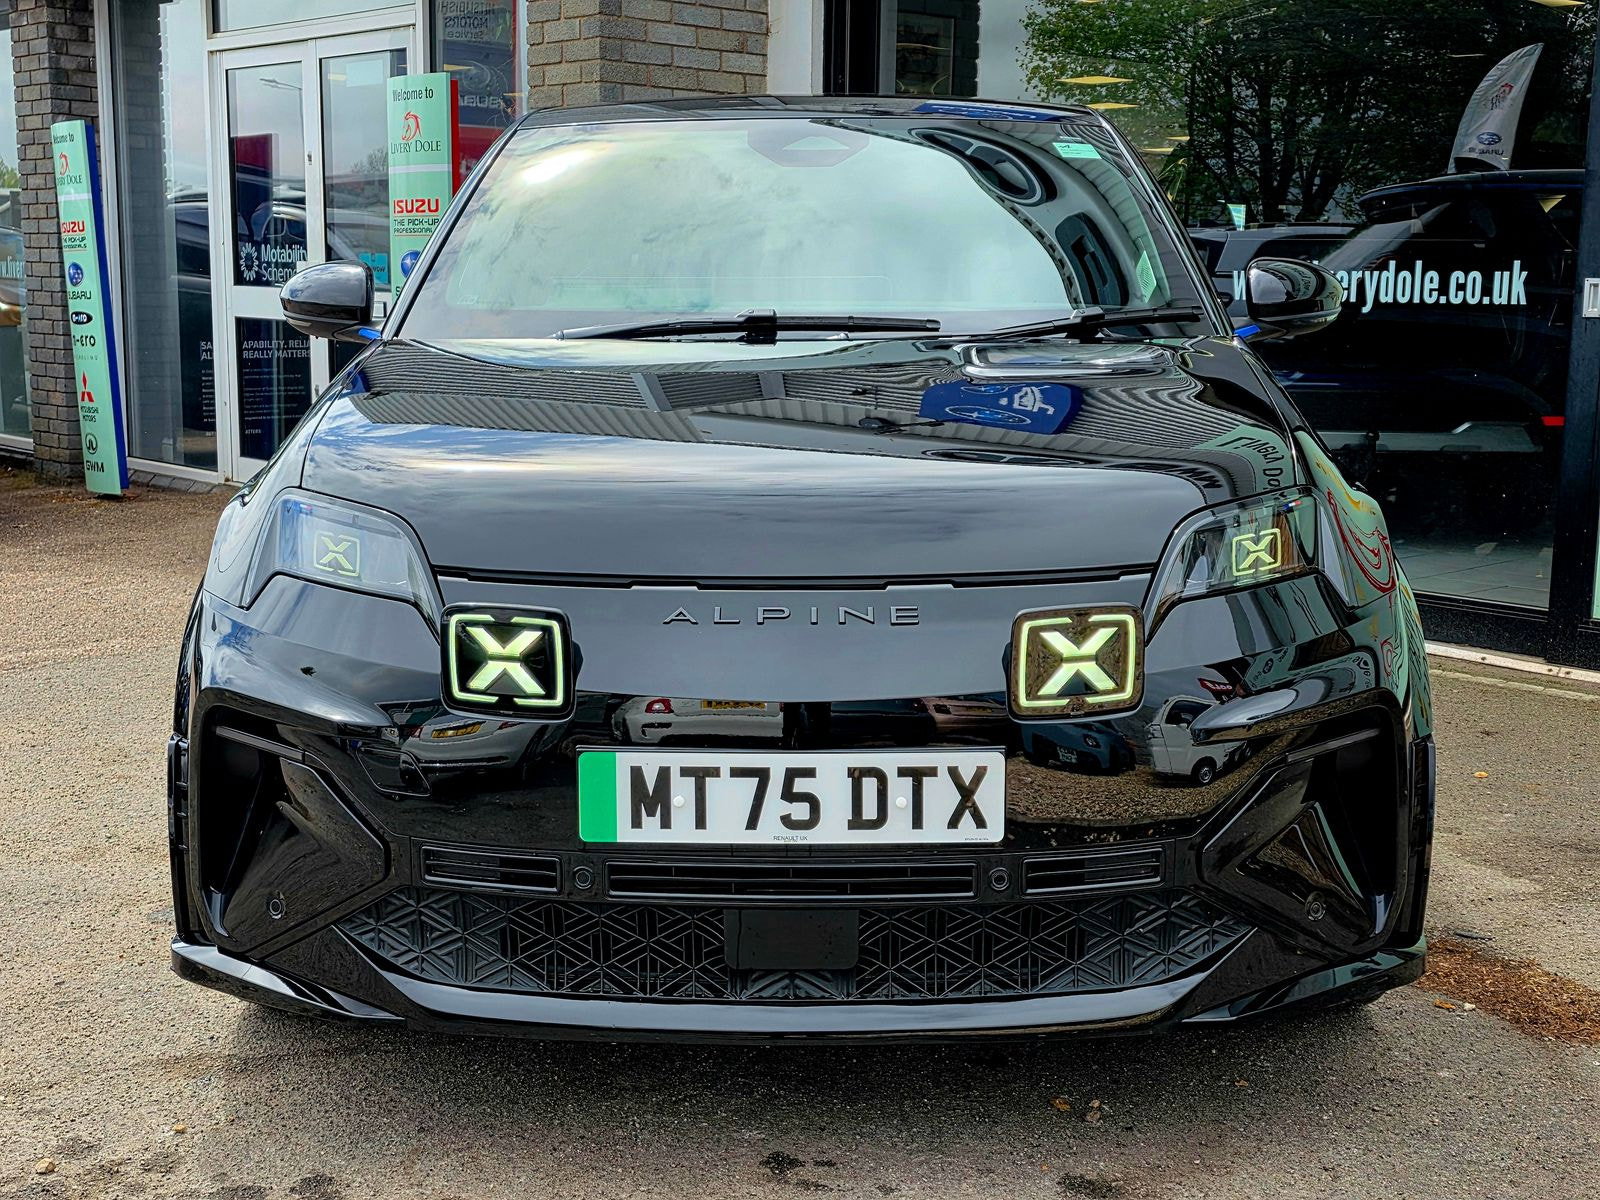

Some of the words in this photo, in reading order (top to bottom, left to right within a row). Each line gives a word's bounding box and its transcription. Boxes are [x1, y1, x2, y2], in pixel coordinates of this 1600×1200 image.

[392, 90, 423, 102] Welcome
[424, 87, 434, 99] to
[390, 142, 411, 154] LIVERY
[415, 139, 442, 152] DOLE
[393, 198, 440, 214] ISUZU
[407, 217, 440, 226] PICK-UP
[242, 351, 273, 359] REALLY
[86, 460, 105, 473] GWM
[662, 605, 921, 625] ALPINE
[629, 765, 821, 831] MT75
[847, 765, 989, 830] DTX
